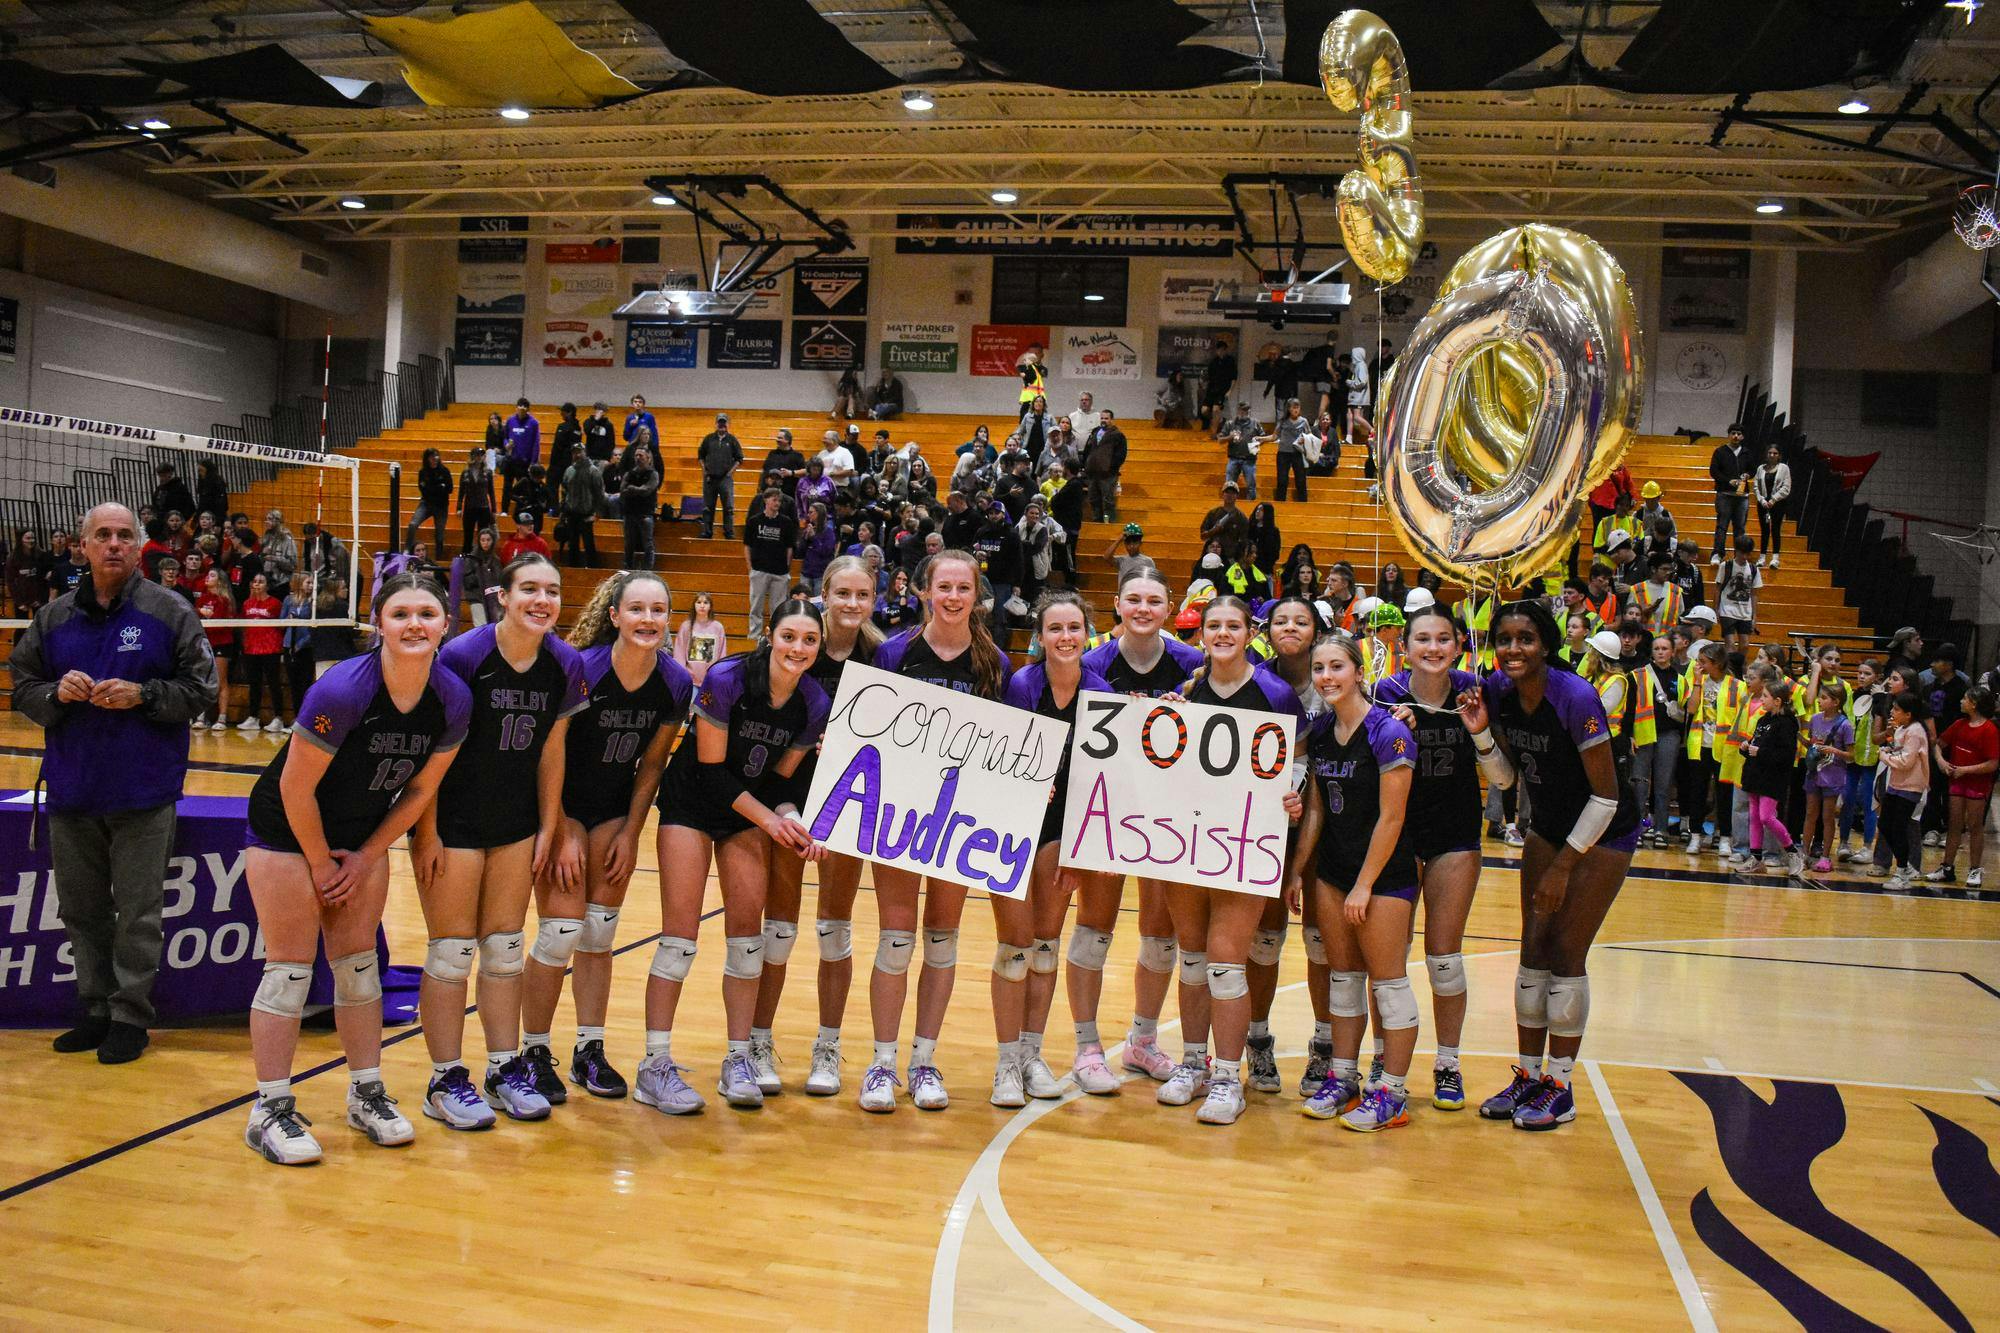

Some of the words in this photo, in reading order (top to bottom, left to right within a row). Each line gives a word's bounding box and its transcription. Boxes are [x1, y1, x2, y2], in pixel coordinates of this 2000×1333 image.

[955, 221, 1057, 245] SHELBY
[1072, 222, 1221, 246] ATHLETICS
[646, 336, 694, 348] Veterinary
[886, 323, 914, 332] MATT
[915, 324, 955, 333] PARKER
[1173, 335, 1212, 349] Rotary
[643, 345, 670, 354] Clinic
[736, 339, 774, 349] HARBOR
[0, 408, 64, 429] SHELBY
[68, 417, 157, 441] VOLLEYBALL
[206, 438, 254, 454] SHELBY
[256, 445, 327, 464] VOLLEYBALL
[490, 688, 550, 712] SHELBY
[499, 713, 537, 751] 16
[598, 709, 657, 729] SHELBY
[738, 719, 795, 747] SHELBY
[828, 683, 1057, 783] Congrats
[367, 732, 432, 756] SHELBY
[601, 731, 640, 763] 10
[1079, 699, 1287, 780] 3000
[1505, 727, 1550, 753] SHELBY
[368, 758, 415, 792] 13
[743, 744, 769, 779] 9
[1313, 757, 1358, 779] SHELBY
[1420, 748, 1455, 777] 12
[1520, 752, 1542, 785] 2
[1326, 780, 1345, 815] 6
[809, 744, 1032, 893] Audrey
[1071, 771, 1283, 886] Assists
